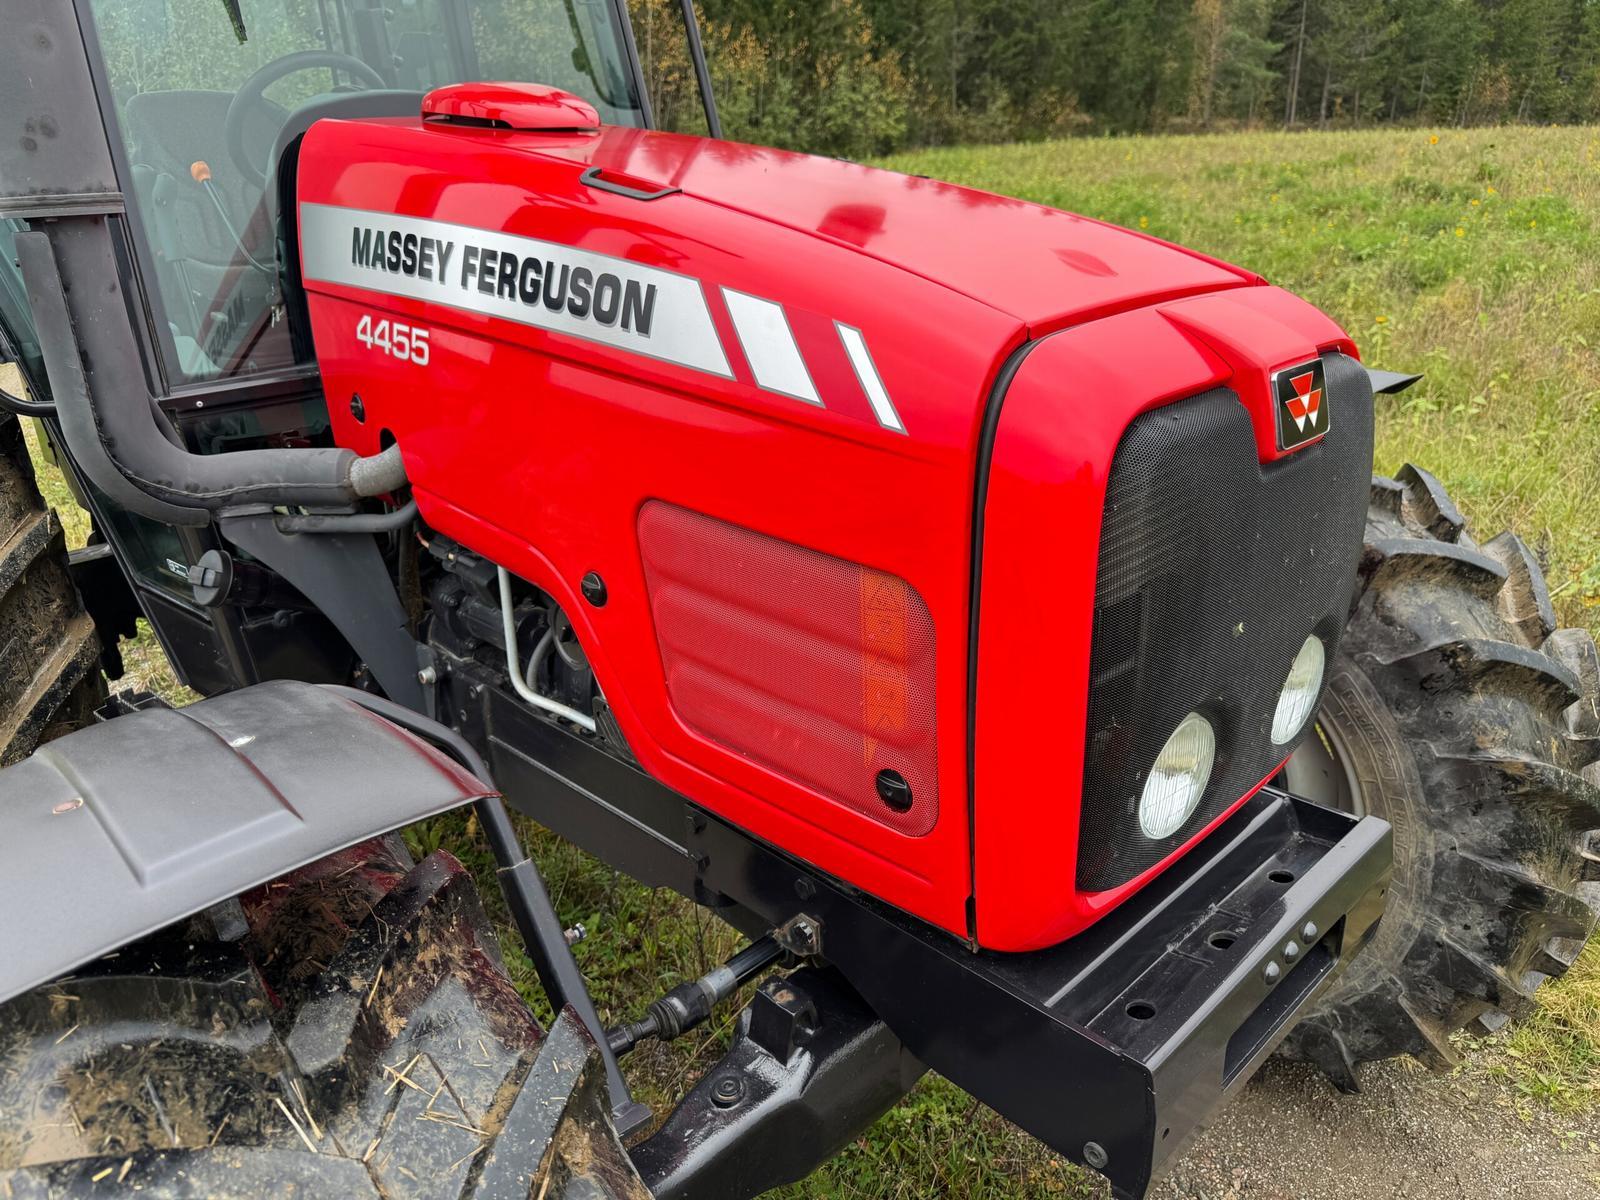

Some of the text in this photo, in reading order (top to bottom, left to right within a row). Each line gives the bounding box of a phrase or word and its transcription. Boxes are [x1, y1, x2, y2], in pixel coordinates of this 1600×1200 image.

[352, 227, 657, 337] MASSEY FERGUSON
[356, 314, 430, 367] 4455
